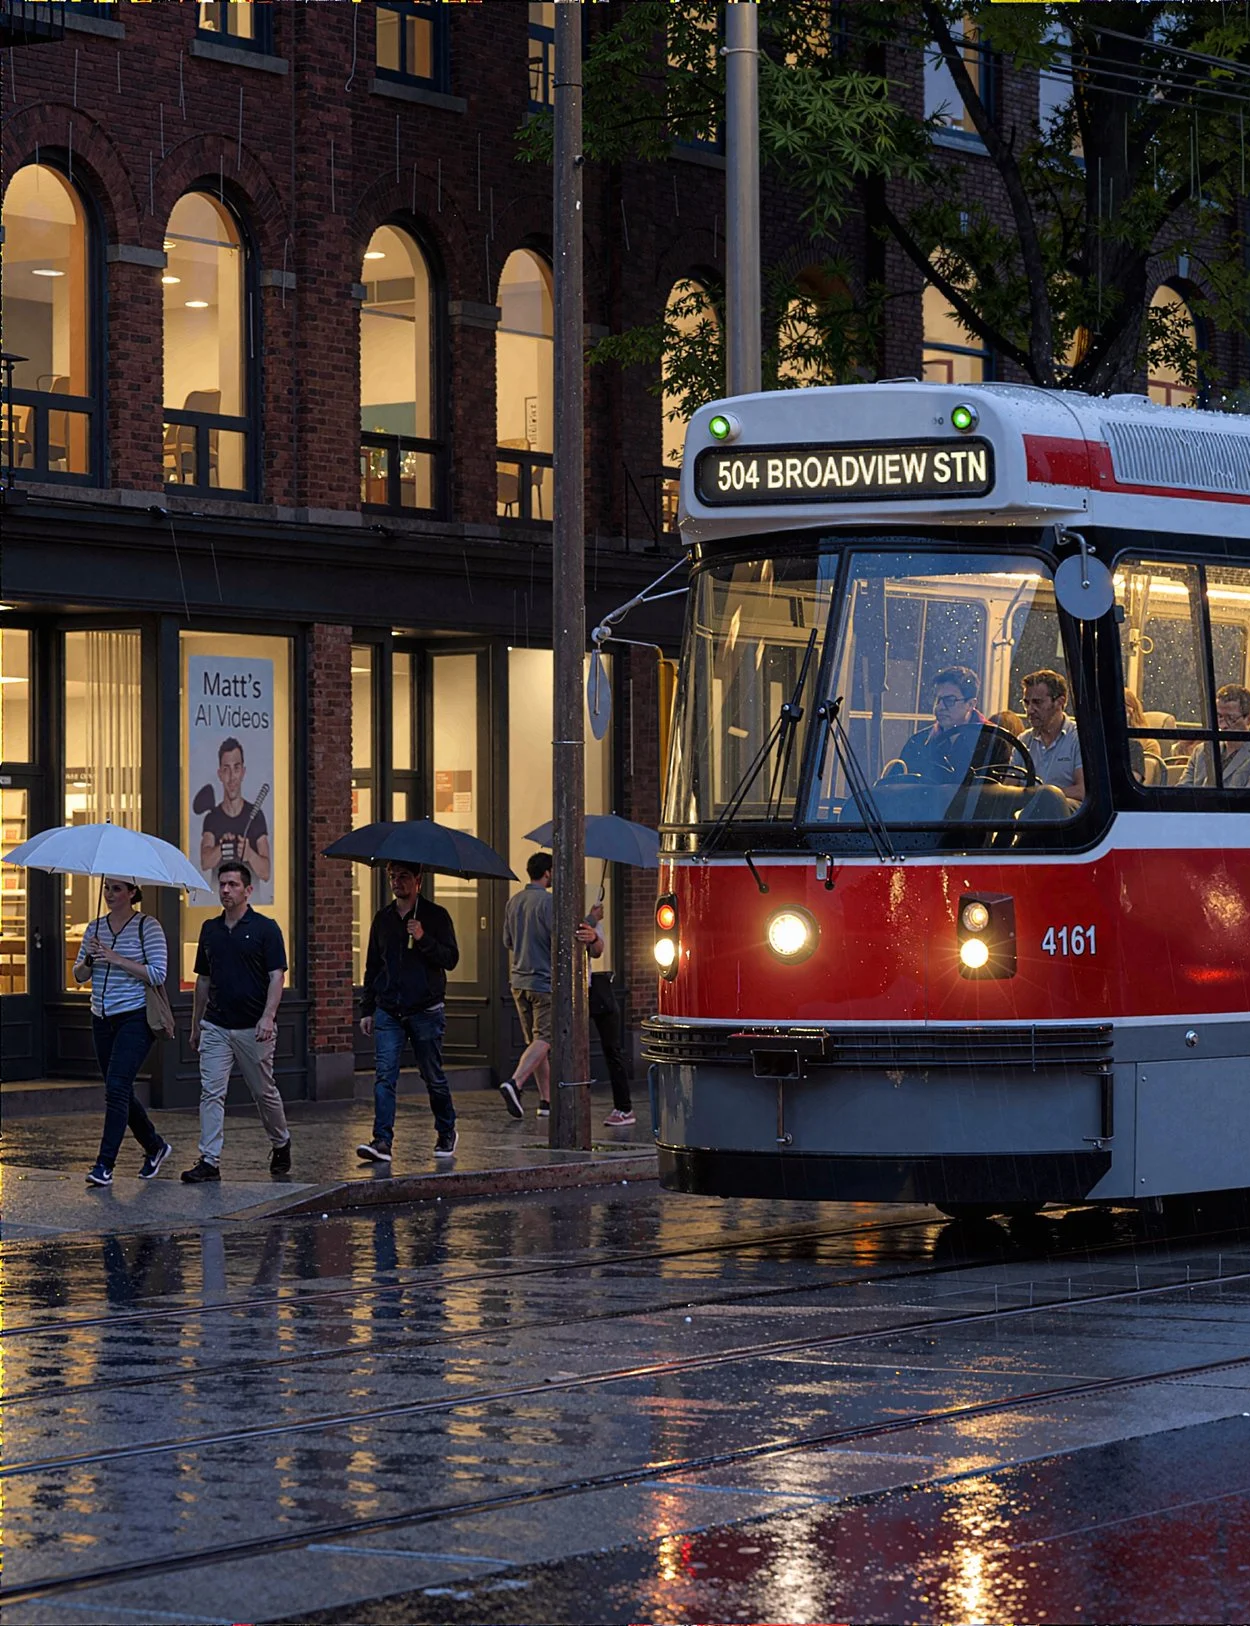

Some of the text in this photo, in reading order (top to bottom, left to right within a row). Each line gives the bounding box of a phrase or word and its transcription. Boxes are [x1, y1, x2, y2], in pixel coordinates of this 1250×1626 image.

[718, 450, 986, 491] 504 BROADVIEW STN
[203, 671, 262, 699] Matt's
[195, 703, 269, 729] AI Videos
[1041, 924, 1096, 956] 4161
